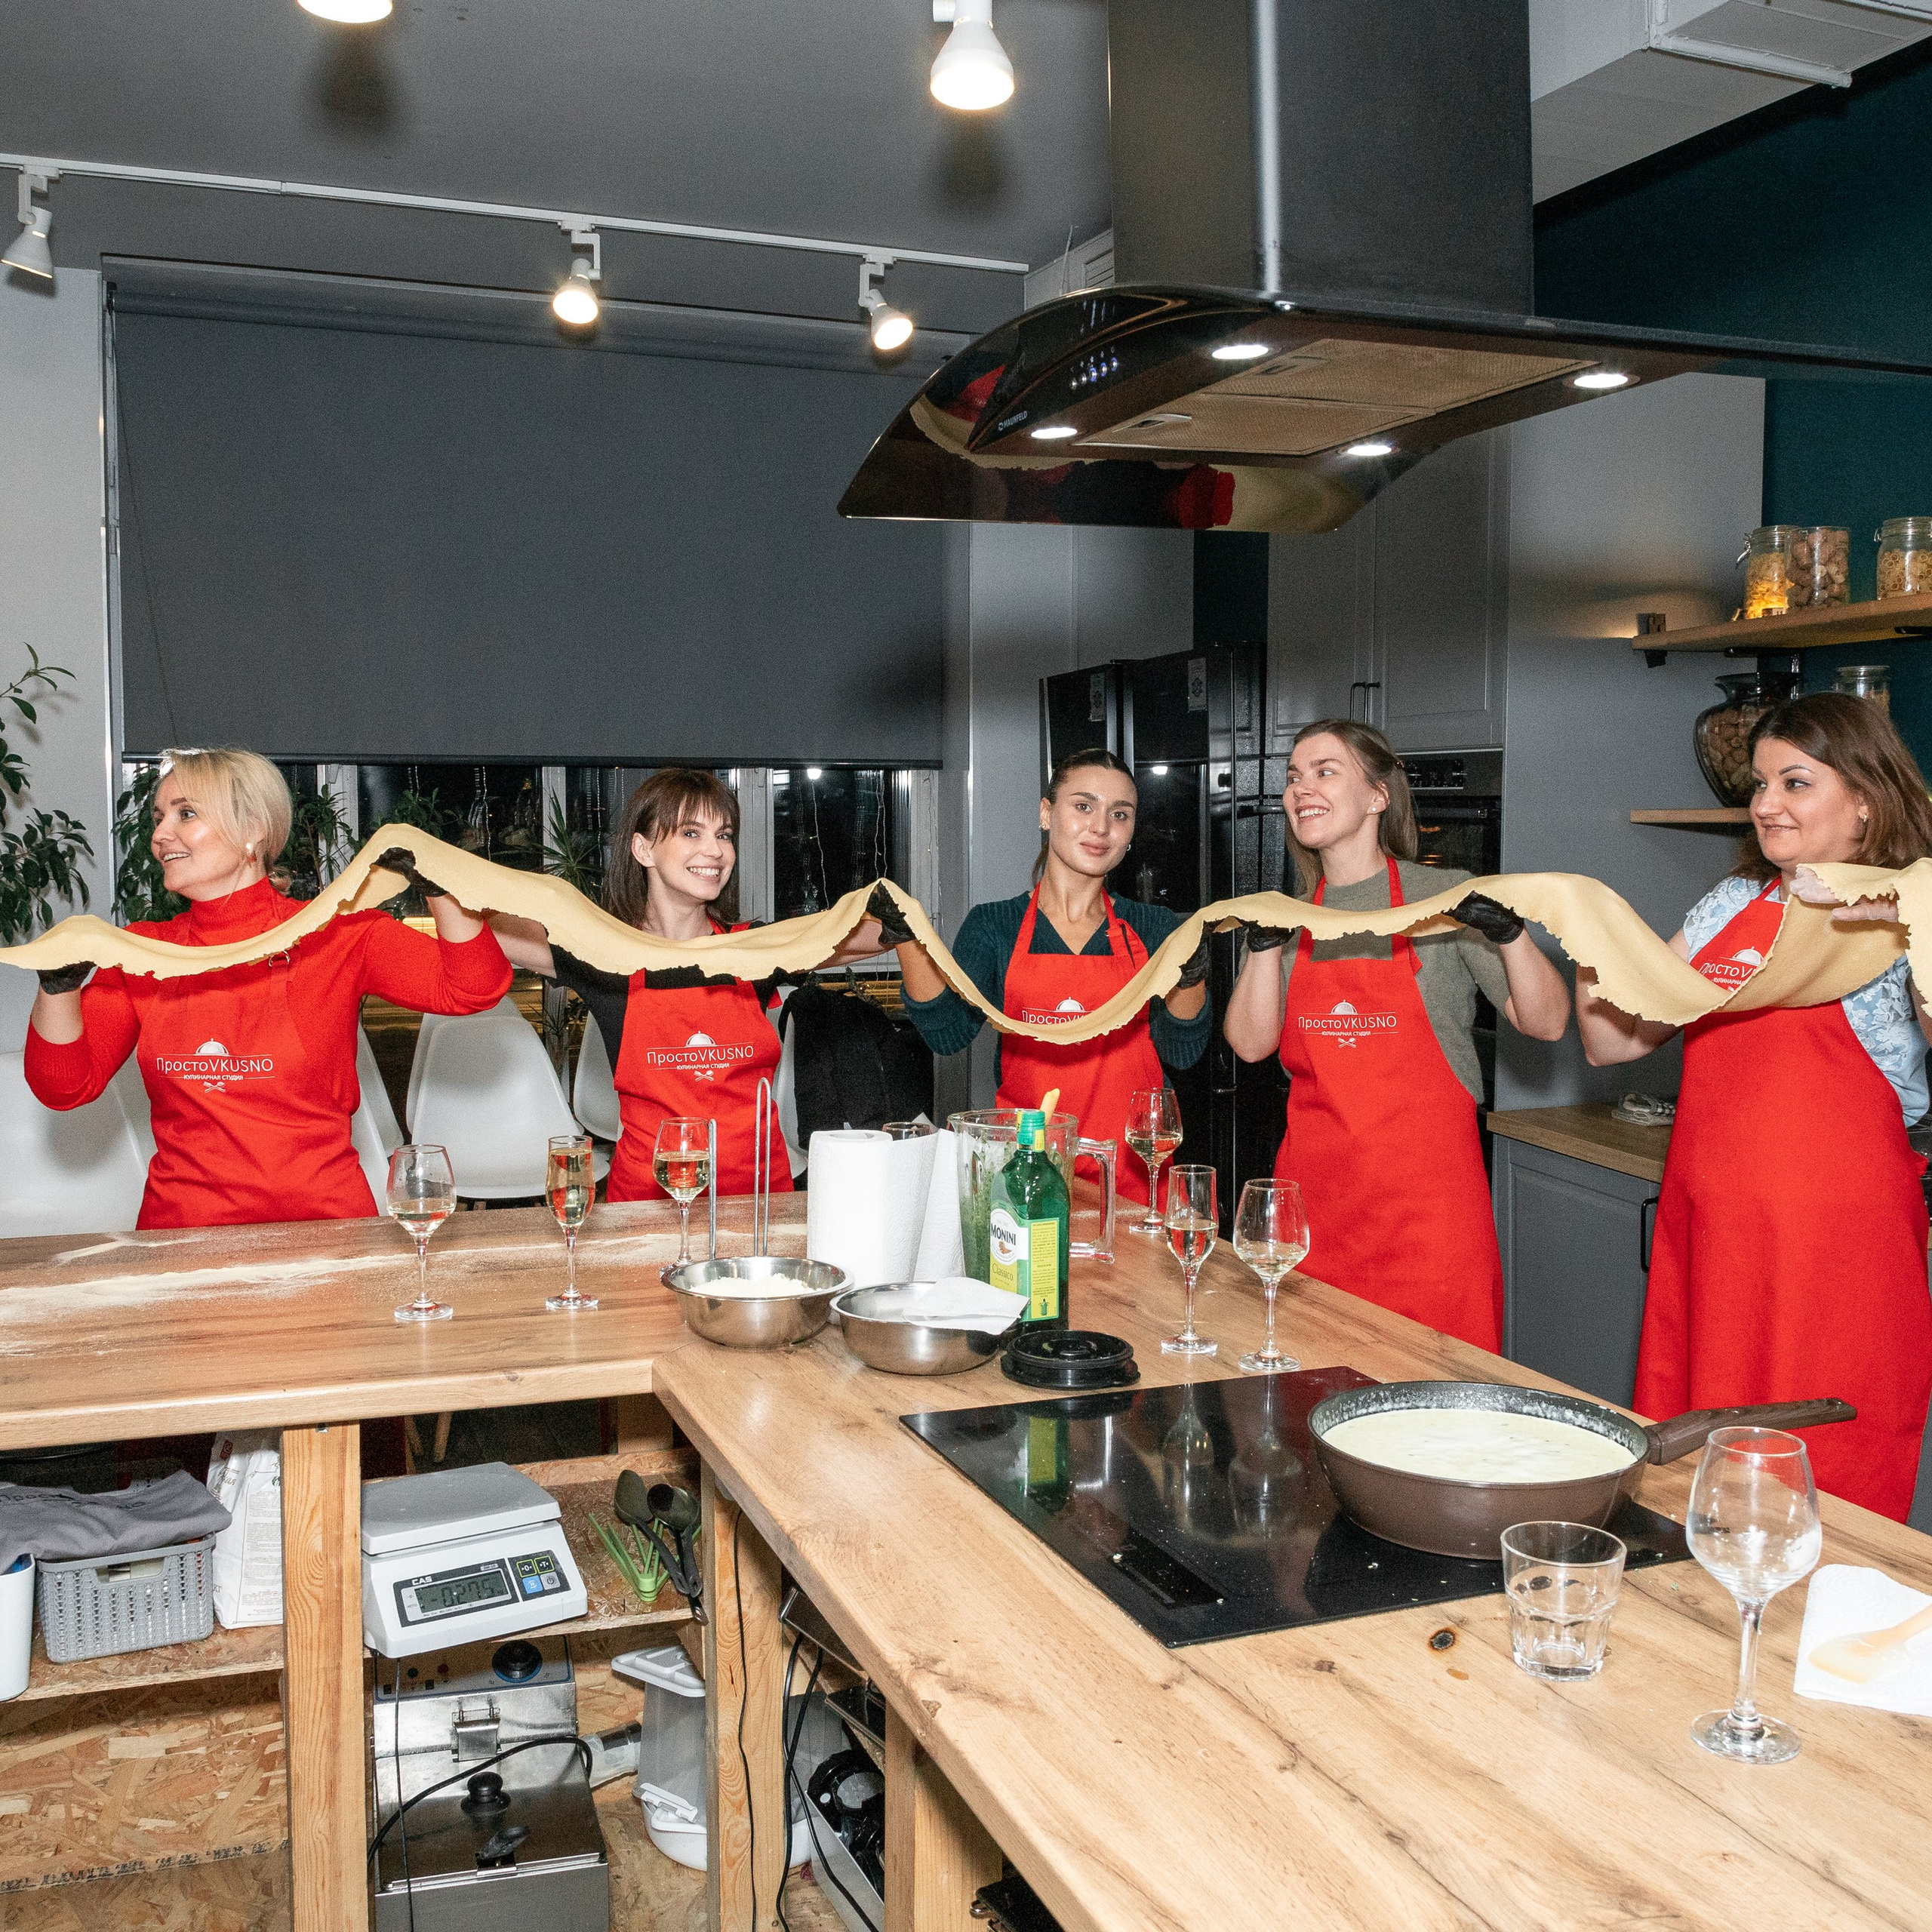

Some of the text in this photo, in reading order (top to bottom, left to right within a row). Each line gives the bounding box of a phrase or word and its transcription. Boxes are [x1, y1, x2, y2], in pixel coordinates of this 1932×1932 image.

[1298, 1015, 1397, 1030] ПростоVKUSNO
[647, 1045, 754, 1066] ПростоVKUSNO
[156, 1057, 274, 1074] ПростоVKUSNO
[990, 1223, 1017, 1246] MONINI
[992, 1263, 1014, 1281] Classico
[411, 1576, 432, 1586] CAS
